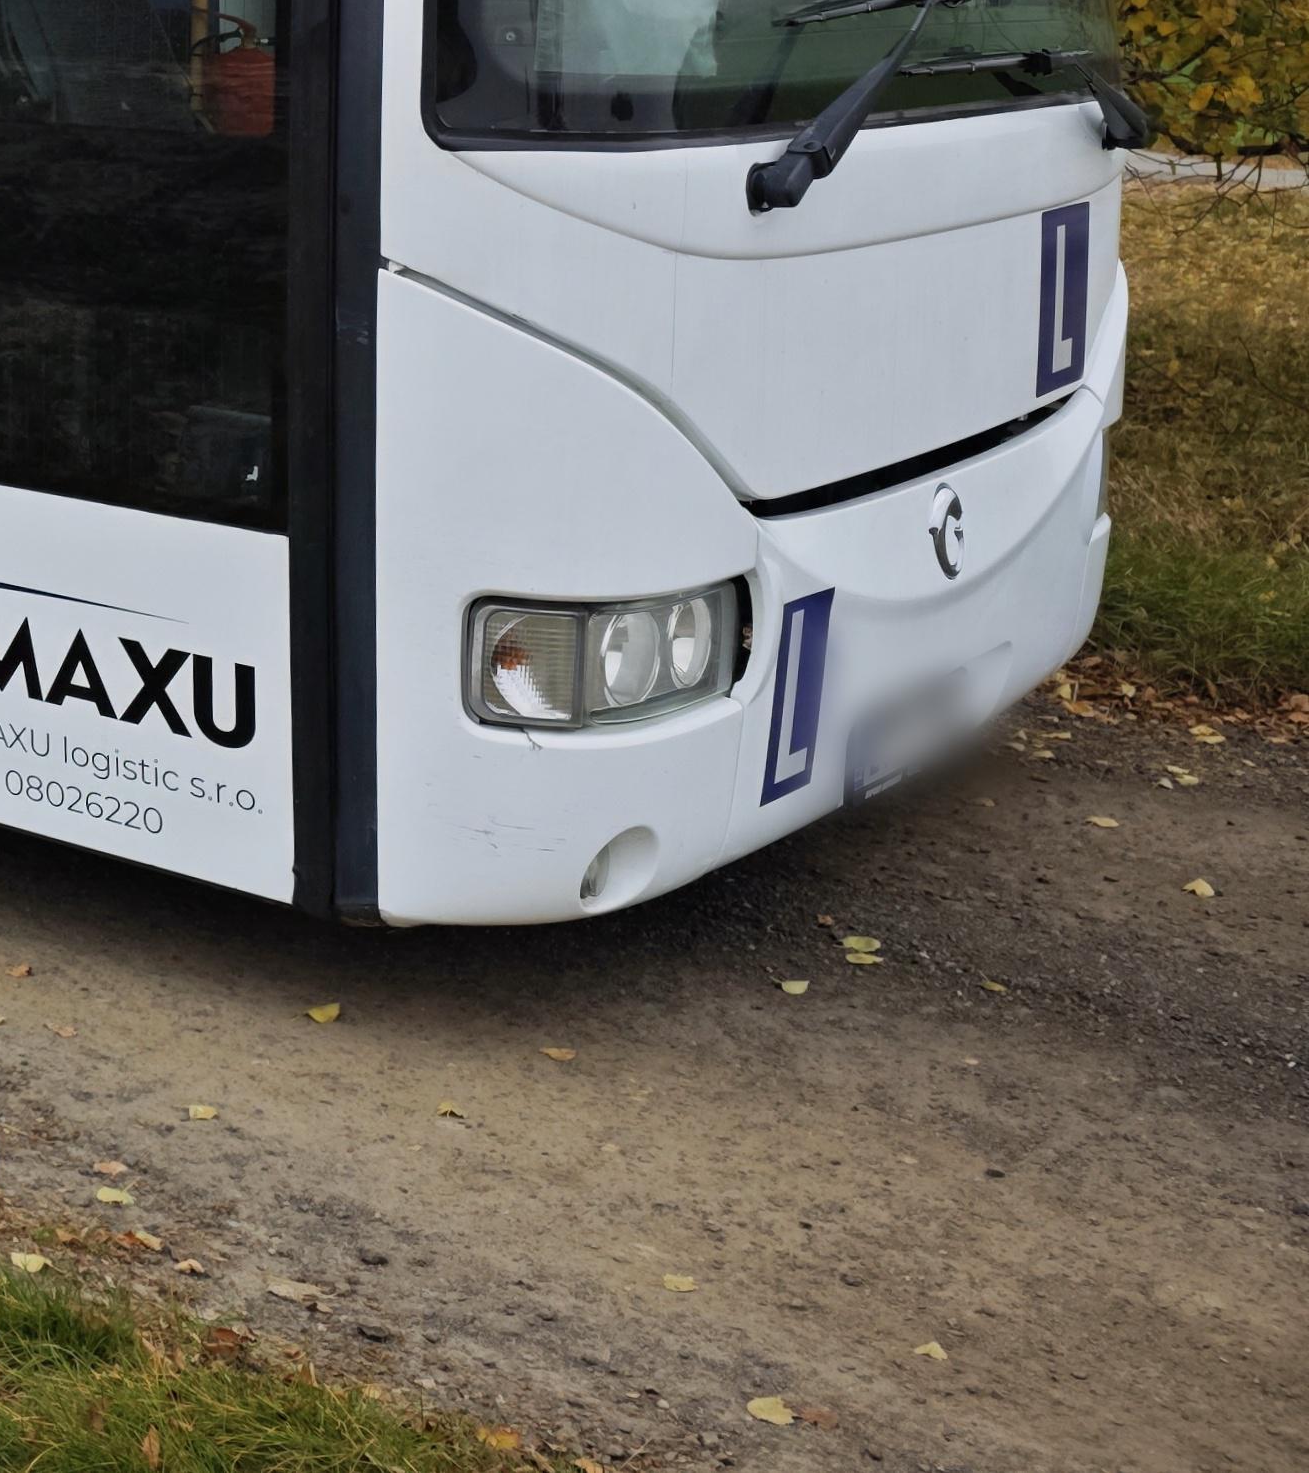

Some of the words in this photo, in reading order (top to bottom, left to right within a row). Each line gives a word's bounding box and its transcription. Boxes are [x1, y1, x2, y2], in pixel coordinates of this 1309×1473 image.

[1051, 223, 1073, 375] L
[773, 608, 808, 786] L
[5, 769, 164, 835] 08026220
[63, 735, 179, 792] logistic
[189, 776, 264, 815] s.r.o.
